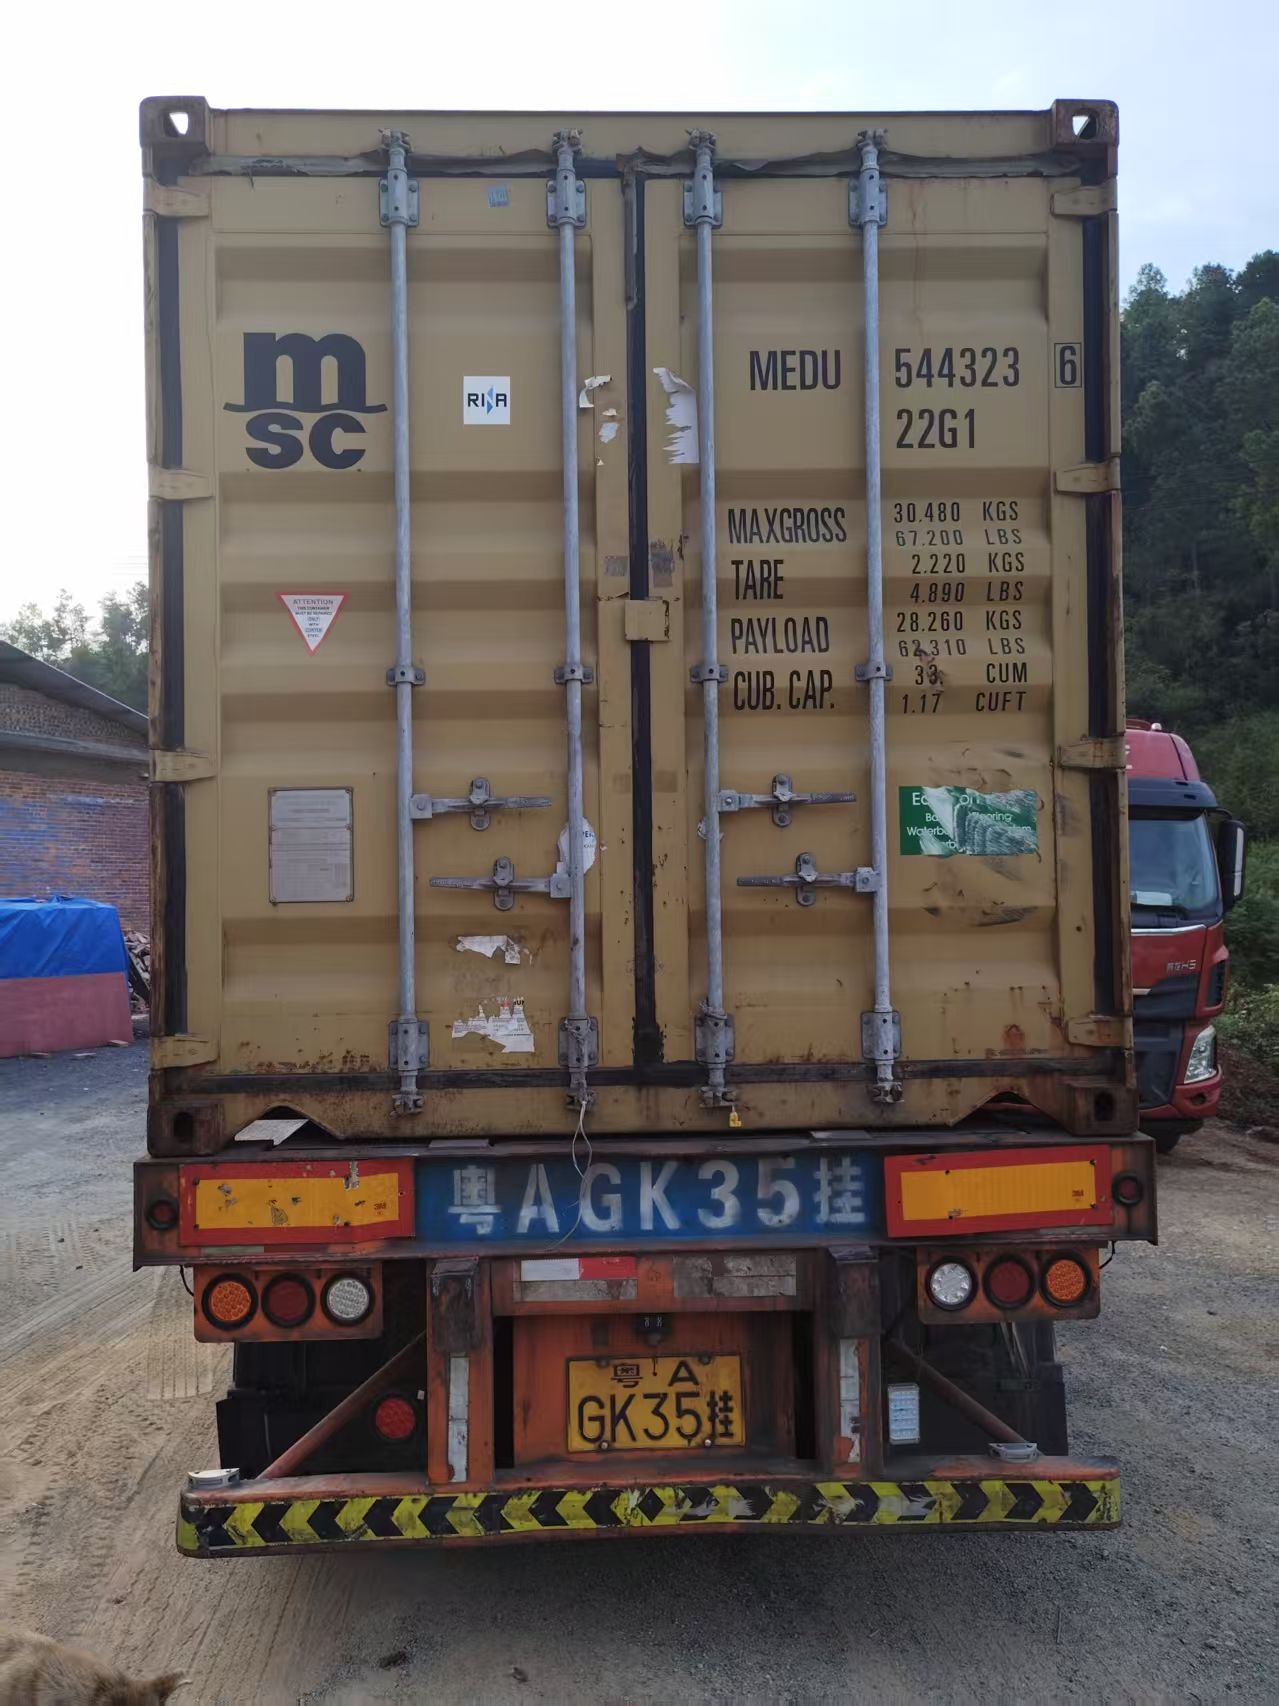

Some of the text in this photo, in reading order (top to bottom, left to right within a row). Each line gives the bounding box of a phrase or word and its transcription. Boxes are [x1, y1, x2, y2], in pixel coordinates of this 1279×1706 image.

[749, 346, 1078, 391] MEDU 544323 6
[896, 408, 976, 449] 22G1
[894, 501, 1019, 523] 30.480 KGS
[728, 507, 848, 545] MAXGROSS
[896, 528, 1022, 547] 67.200 LBS
[911, 552, 1025, 574] 2.220 KGS
[731, 559, 784, 600] TARE
[910, 581, 1024, 603] 4.890 LBS
[896, 610, 1022, 632] 28.260 KGS
[731, 616, 830, 654] PAYLOAD
[898, 637, 1025, 657] 62.310 LBS
[986, 662, 1028, 683] CUM
[734, 669, 835, 711] CUB. CAP.
[902, 691, 1027, 714] 1.17 CUFT
[578, 1390, 735, 1444] GK35挂
